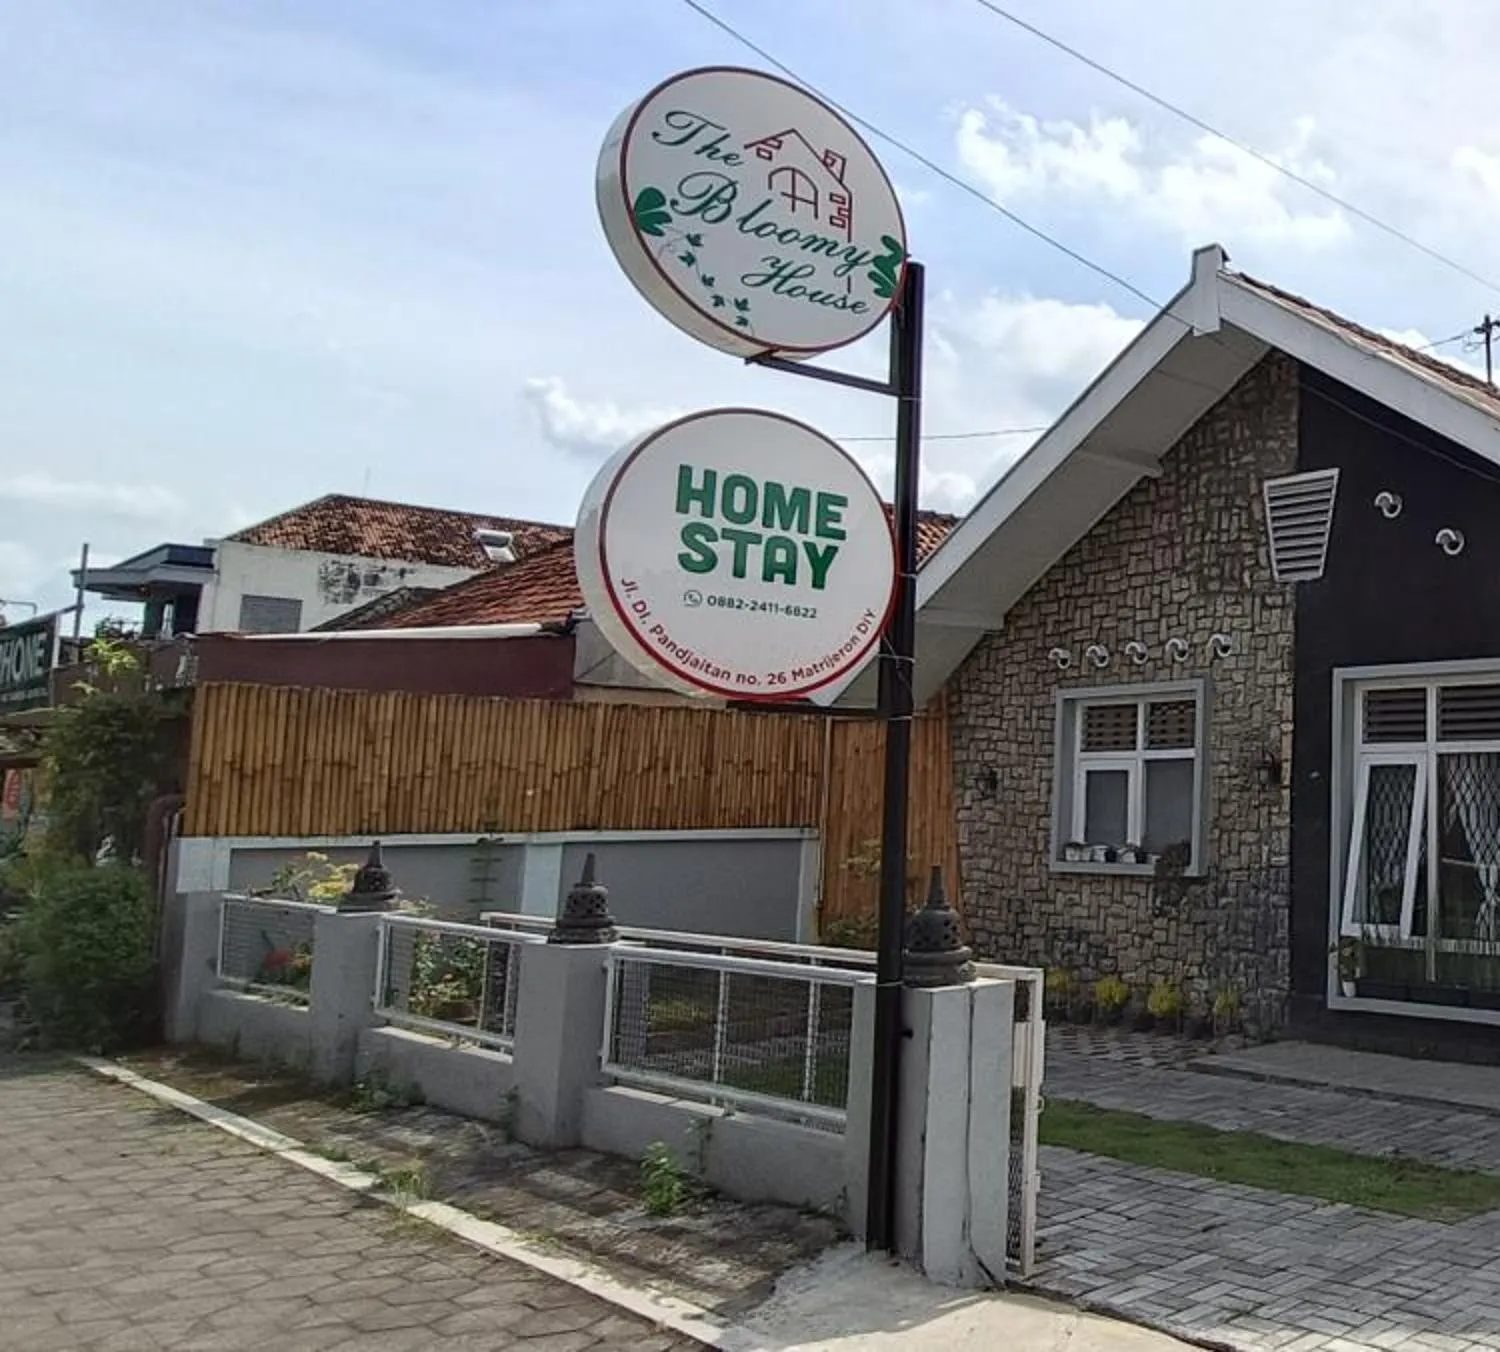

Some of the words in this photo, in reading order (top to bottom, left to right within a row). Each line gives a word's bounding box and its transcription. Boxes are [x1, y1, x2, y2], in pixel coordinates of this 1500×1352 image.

[652, 110, 745, 167] The
[669, 171, 876, 277] Bloomy
[740, 255, 871, 315] House
[675, 463, 849, 541] HOME
[677, 521, 839, 590] STAY
[649, 623, 732, 681] Pandjaitan
[735, 673, 762, 686] no.
[767, 671, 787, 686] 26
[791, 635, 862, 682] Matrijeron
[856, 607, 877, 635] DIY
